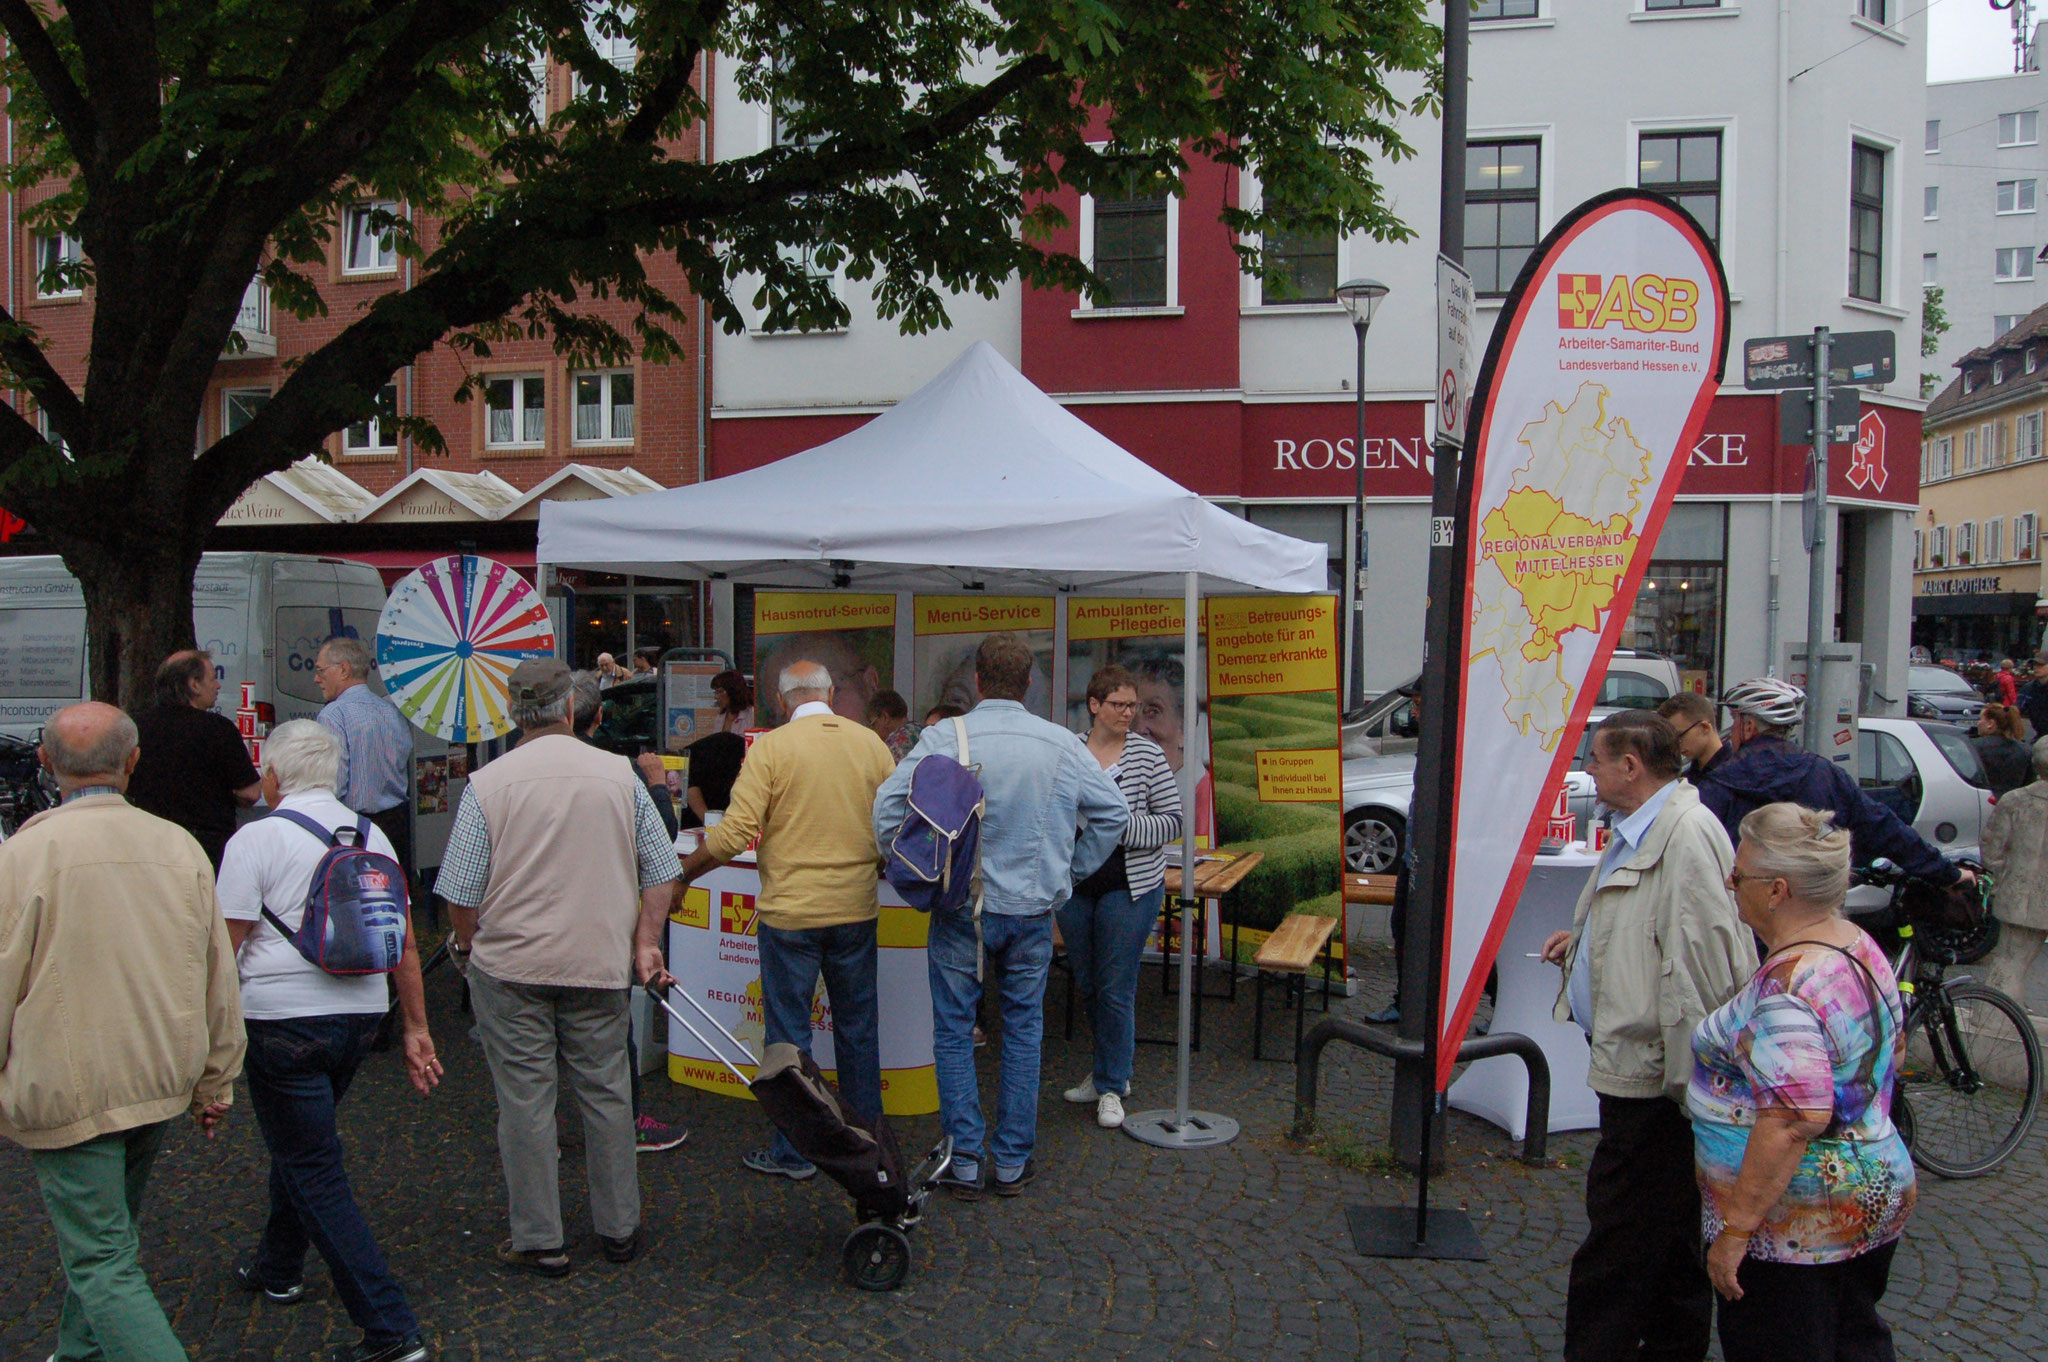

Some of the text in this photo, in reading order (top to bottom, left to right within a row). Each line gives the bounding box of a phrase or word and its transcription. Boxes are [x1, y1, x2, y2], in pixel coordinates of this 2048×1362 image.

[1591, 273, 1699, 333] ASB
[1558, 336, 1699, 354] Arbeiter-Samariter-Bund
[1559, 359, 1701, 373] Landesverband Hessen e.V.
[245, 501, 285, 519] Weine
[399, 500, 456, 519] Vinothek
[1484, 533, 1623, 554] REGIONALVERBAND
[1515, 554, 1625, 574] MITTELHESSEN
[44, 583, 75, 594] GmbH
[1921, 576, 2001, 594] MARKT APOTHEKE
[761, 603, 891, 622] Hausnotruf-Service
[927, 604, 1041, 624] Menü-Service
[1075, 603, 1170, 620] Ambulanter-
[1247, 607, 1327, 625] Betreuungs-
[1109, 614, 1206, 634] Pflegediet
[1215, 627, 1315, 649] angebote für an
[1217, 646, 1328, 667] Demenz erkrankte
[1218, 670, 1284, 687] Menschen
[1269, 757, 1314, 768] in Gruppen
[1270, 773, 1327, 783] individuell bei
[1272, 785, 1294, 794] Ihnen
[1306, 785, 1333, 794] Hause
